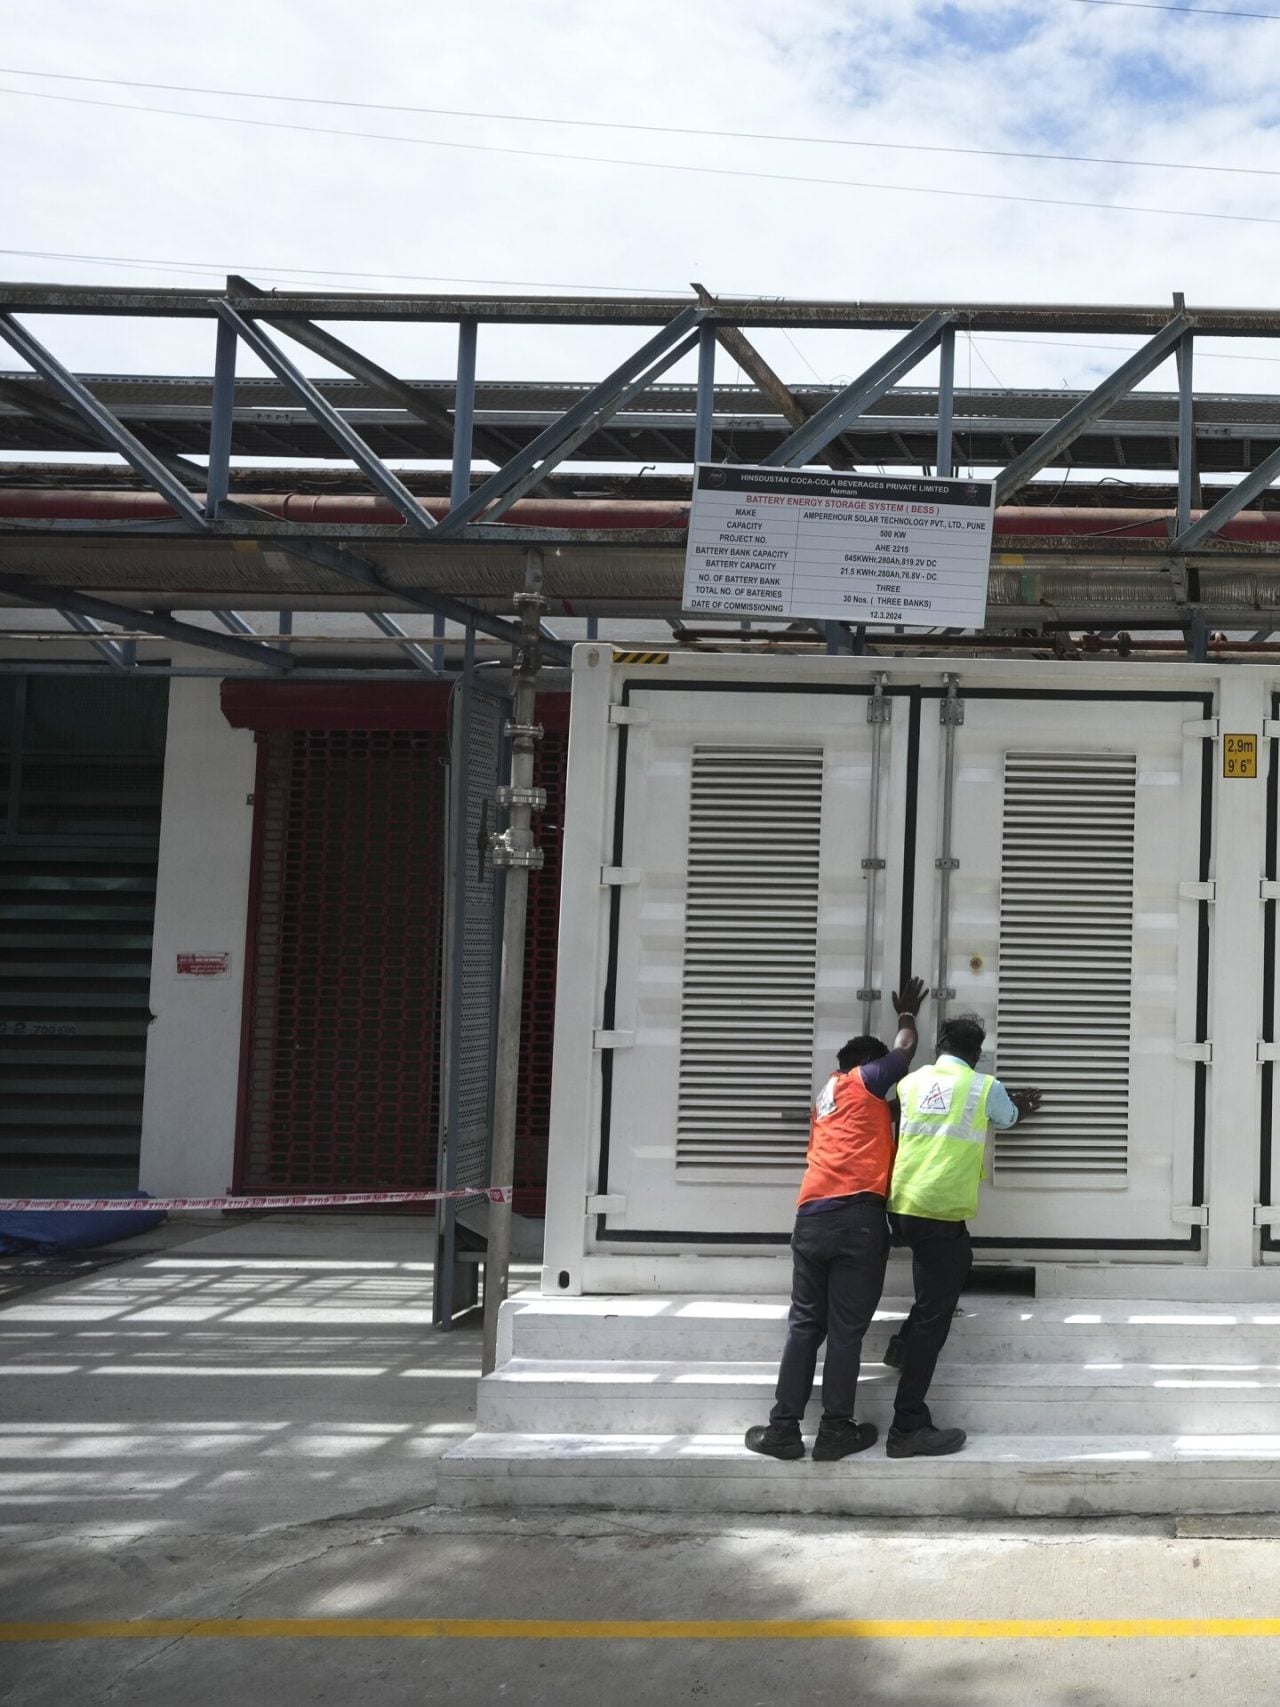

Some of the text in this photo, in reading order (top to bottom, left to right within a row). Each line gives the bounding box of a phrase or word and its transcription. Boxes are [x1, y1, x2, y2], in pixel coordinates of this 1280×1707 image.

[791, 477, 836, 486] COCA-COLA
[838, 480, 884, 489] BEVERAGES
[886, 483, 917, 491] PRIVATE
[919, 485, 949, 493] LIMITED
[746, 495, 785, 505] BATTERY
[787, 497, 822, 508] ENERGY
[825, 499, 866, 510] STORAGE
[869, 502, 903, 511] SYSTEM
[911, 505, 934, 514] BESS
[735, 508, 756, 516] MAKE
[727, 521, 763, 530] CAPACITY
[803, 512, 853, 522] AMPEREHOUR
[854, 515, 879, 523] SOLAR
[881, 516, 928, 527] TECHNOLOGY
[966, 522, 986, 530] PUNE
[720, 534, 767, 544] PROJECT NO.
[880, 530, 906, 539] 500 KW
[696, 547, 789, 559] BATTERY BANK CAPACITY
[875, 544, 909, 553] AHE 2215
[705, 559, 776, 570] BATTERY CAPACITY
[926, 559, 937, 567] DC
[713, 574, 723, 582] OF
[725, 575, 758, 584] BATTERY
[760, 577, 781, 586] BANK
[696, 586, 718, 594] TOTAL
[735, 588, 745, 596] OF
[746, 589, 783, 598] BATERIES
[876, 584, 901, 593] THREE
[843, 595, 852, 603] 30
[853, 596, 868, 604] Nos.
[877, 597, 901, 605] THREE
[691, 600, 784, 613] DATE OF COMMISSIONING
[870, 611, 902, 620] 12.3.2024
